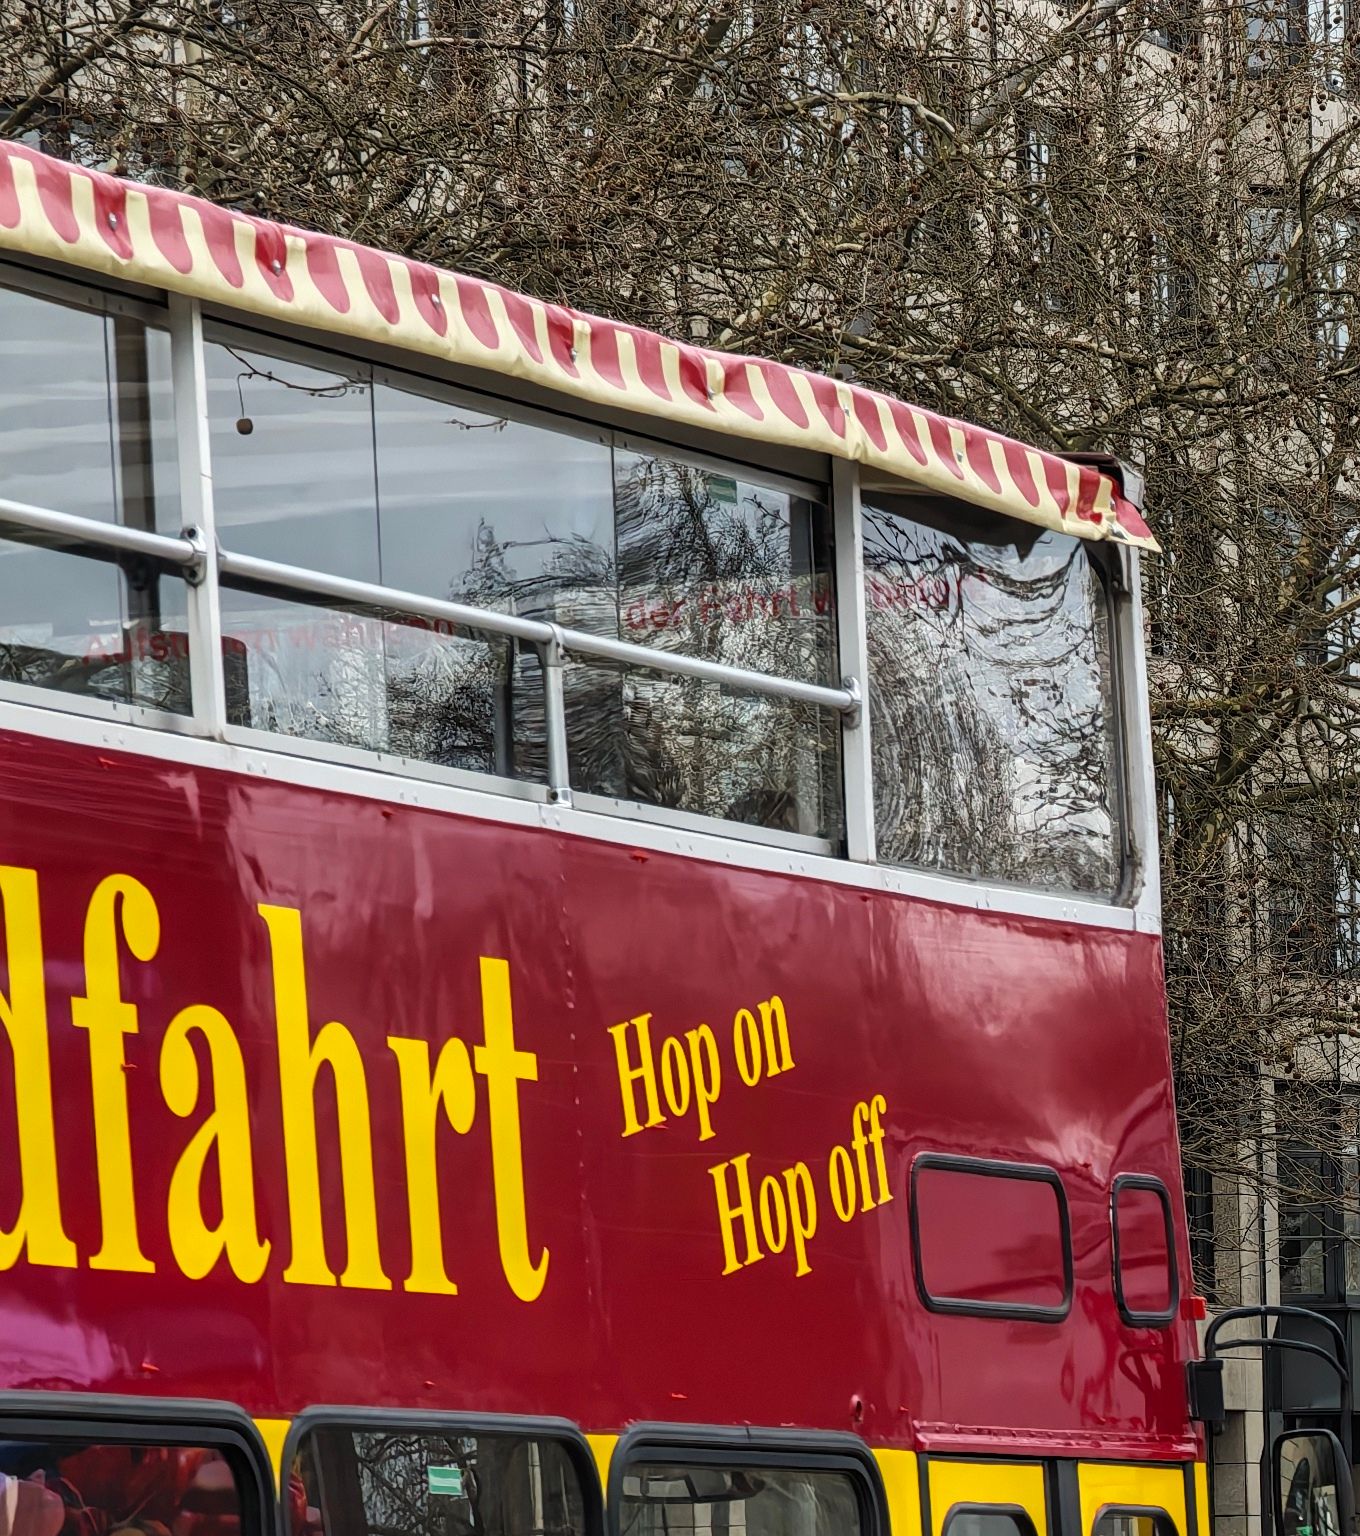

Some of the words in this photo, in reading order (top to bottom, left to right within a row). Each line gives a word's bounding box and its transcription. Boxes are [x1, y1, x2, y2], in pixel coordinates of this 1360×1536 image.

[607, 1012, 721, 1142] Hop
[734, 995, 795, 1088] on
[707, 1152, 817, 1277] Hop
[828, 1093, 894, 1224] off
